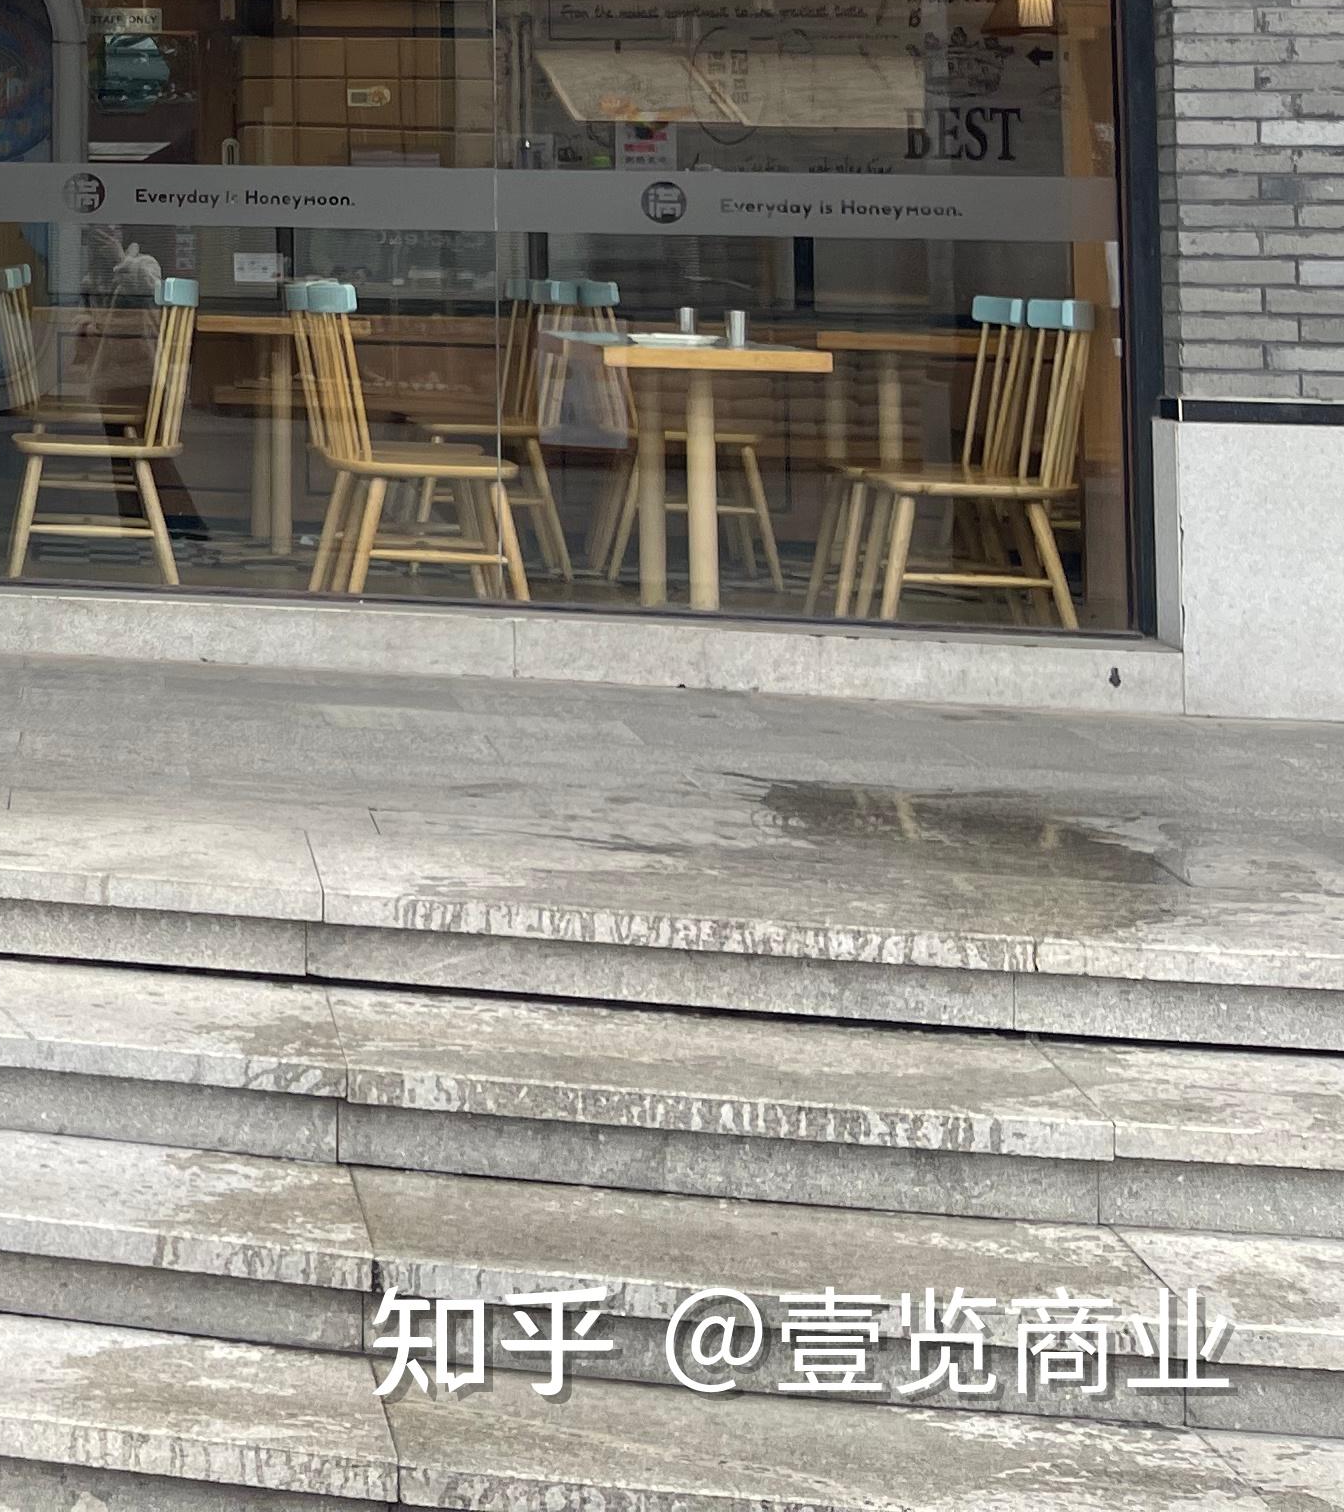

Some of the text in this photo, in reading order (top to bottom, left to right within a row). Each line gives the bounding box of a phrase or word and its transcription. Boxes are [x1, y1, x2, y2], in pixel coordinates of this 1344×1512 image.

[128, 14, 158, 25] ONLY
[904, 107, 1023, 161] BEST
[135, 187, 219, 209] Everyday
[720, 198, 812, 219] Everyday
